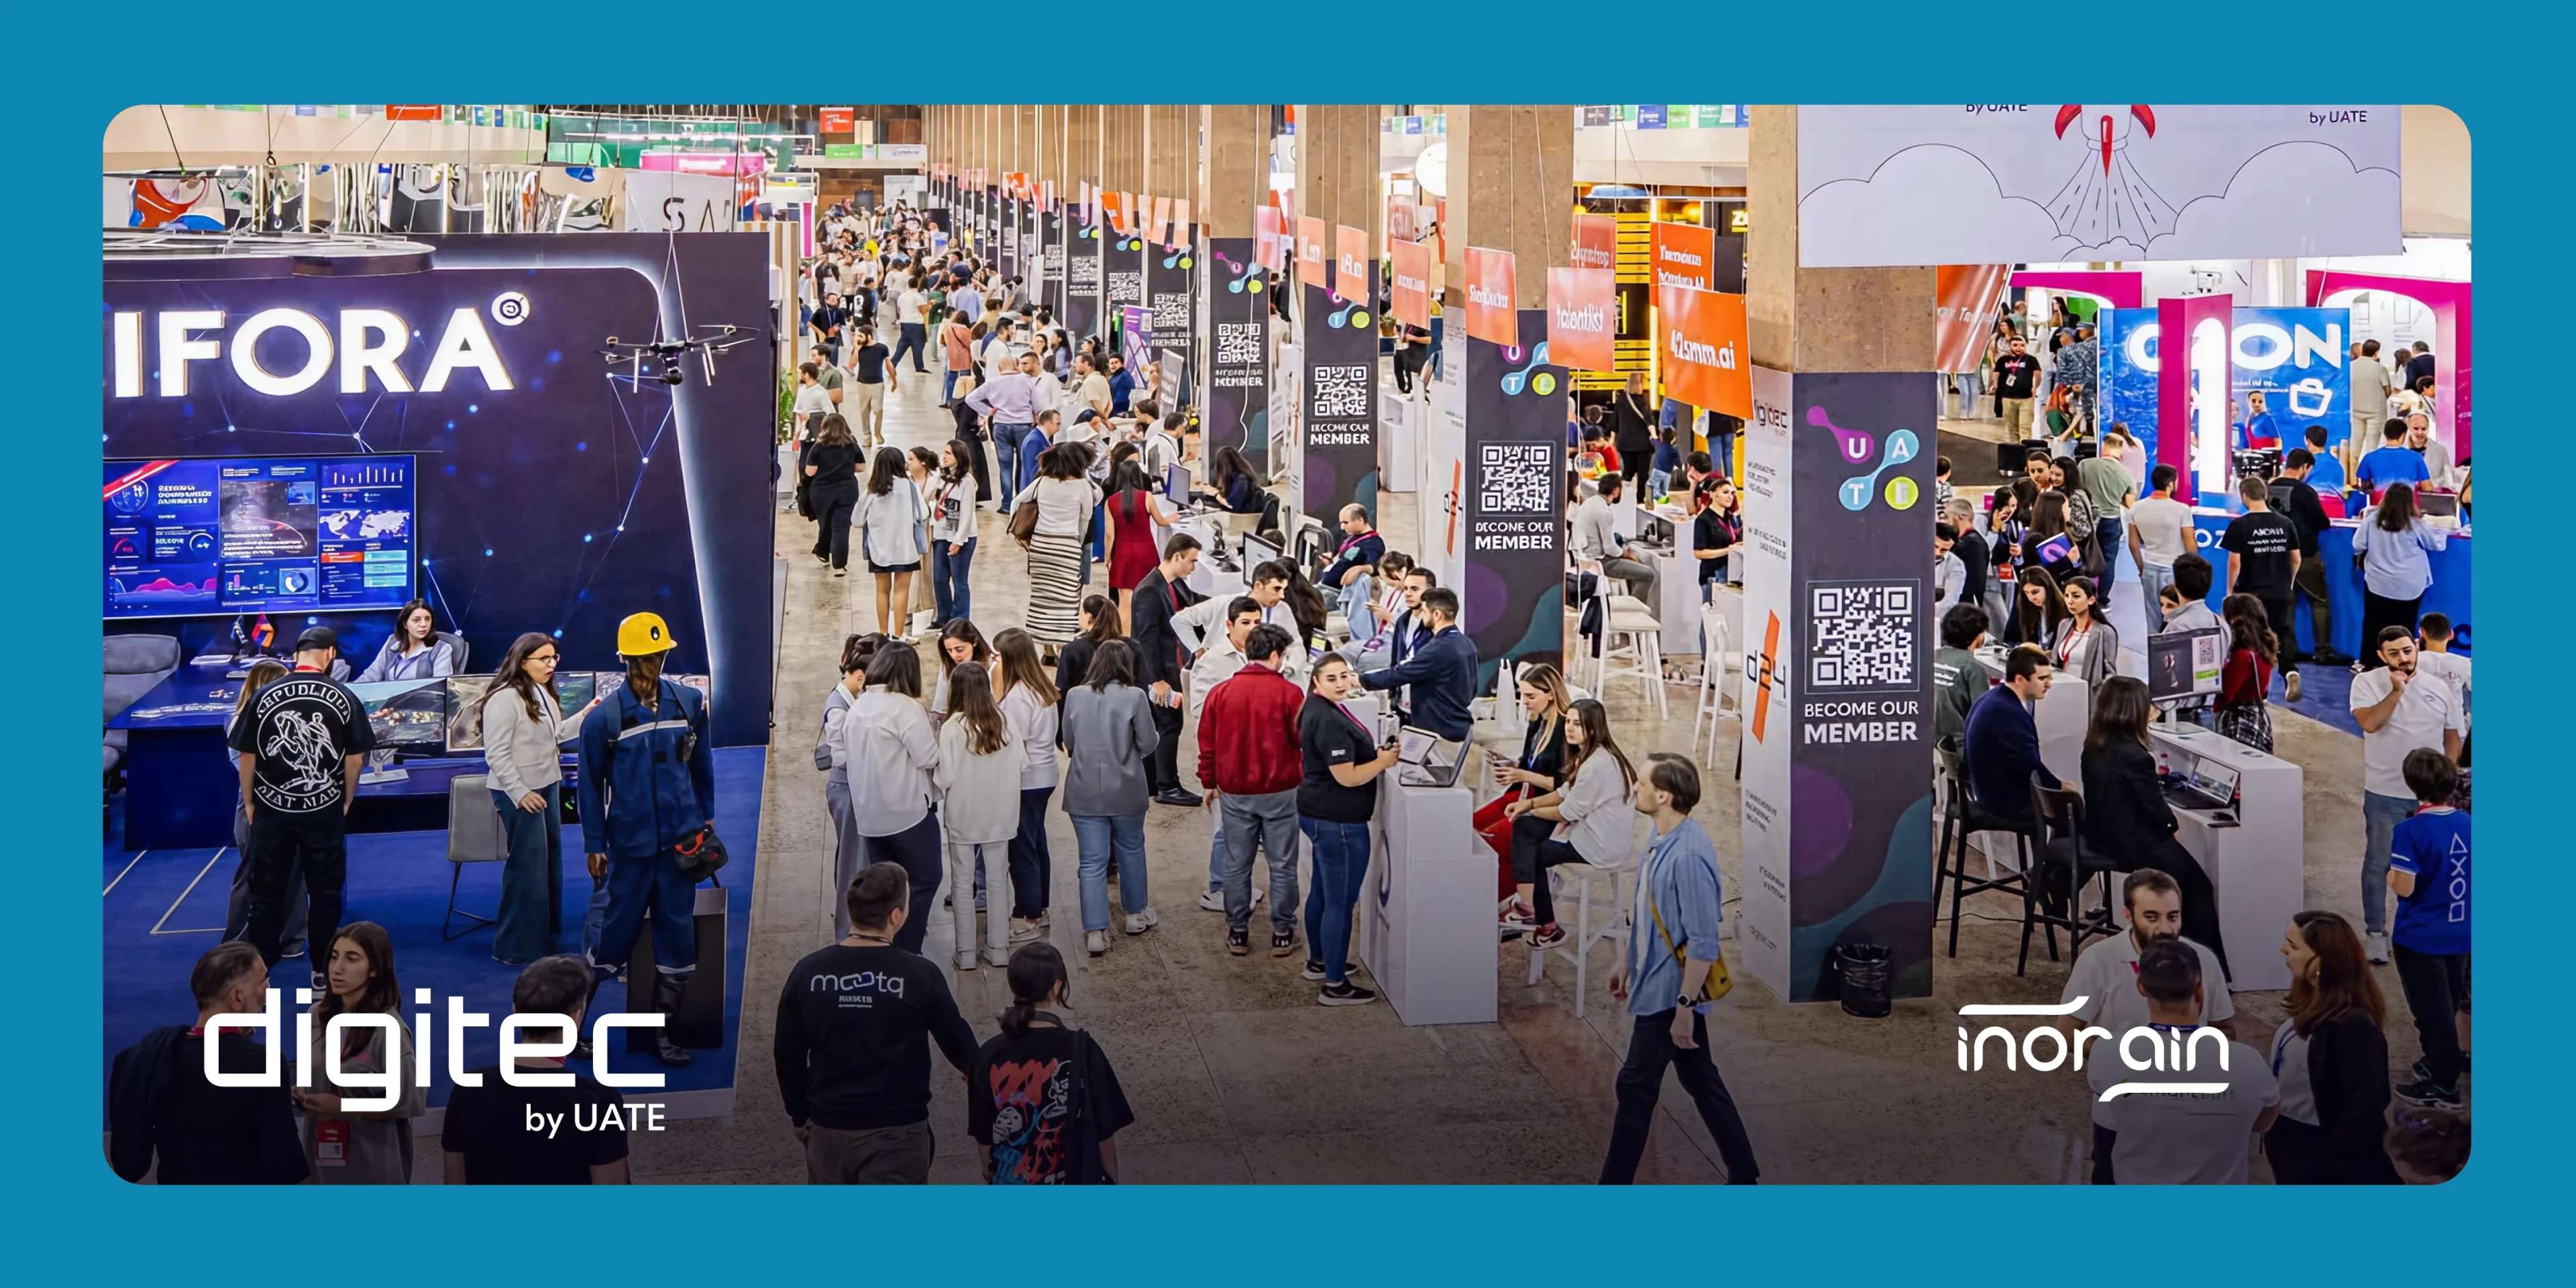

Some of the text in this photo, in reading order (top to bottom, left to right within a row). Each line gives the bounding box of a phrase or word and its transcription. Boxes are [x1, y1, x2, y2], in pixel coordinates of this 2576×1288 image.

[2310, 111, 2367, 126] by UATE
[114, 307, 515, 398] IFORA
[1310, 433, 1371, 445] MEMBER
[1527, 521, 1554, 533] OUR
[1475, 535, 1553, 550] MEMBER
[1805, 701, 1919, 718] BECOME OUR
[1805, 720, 1919, 745] MEMBER
